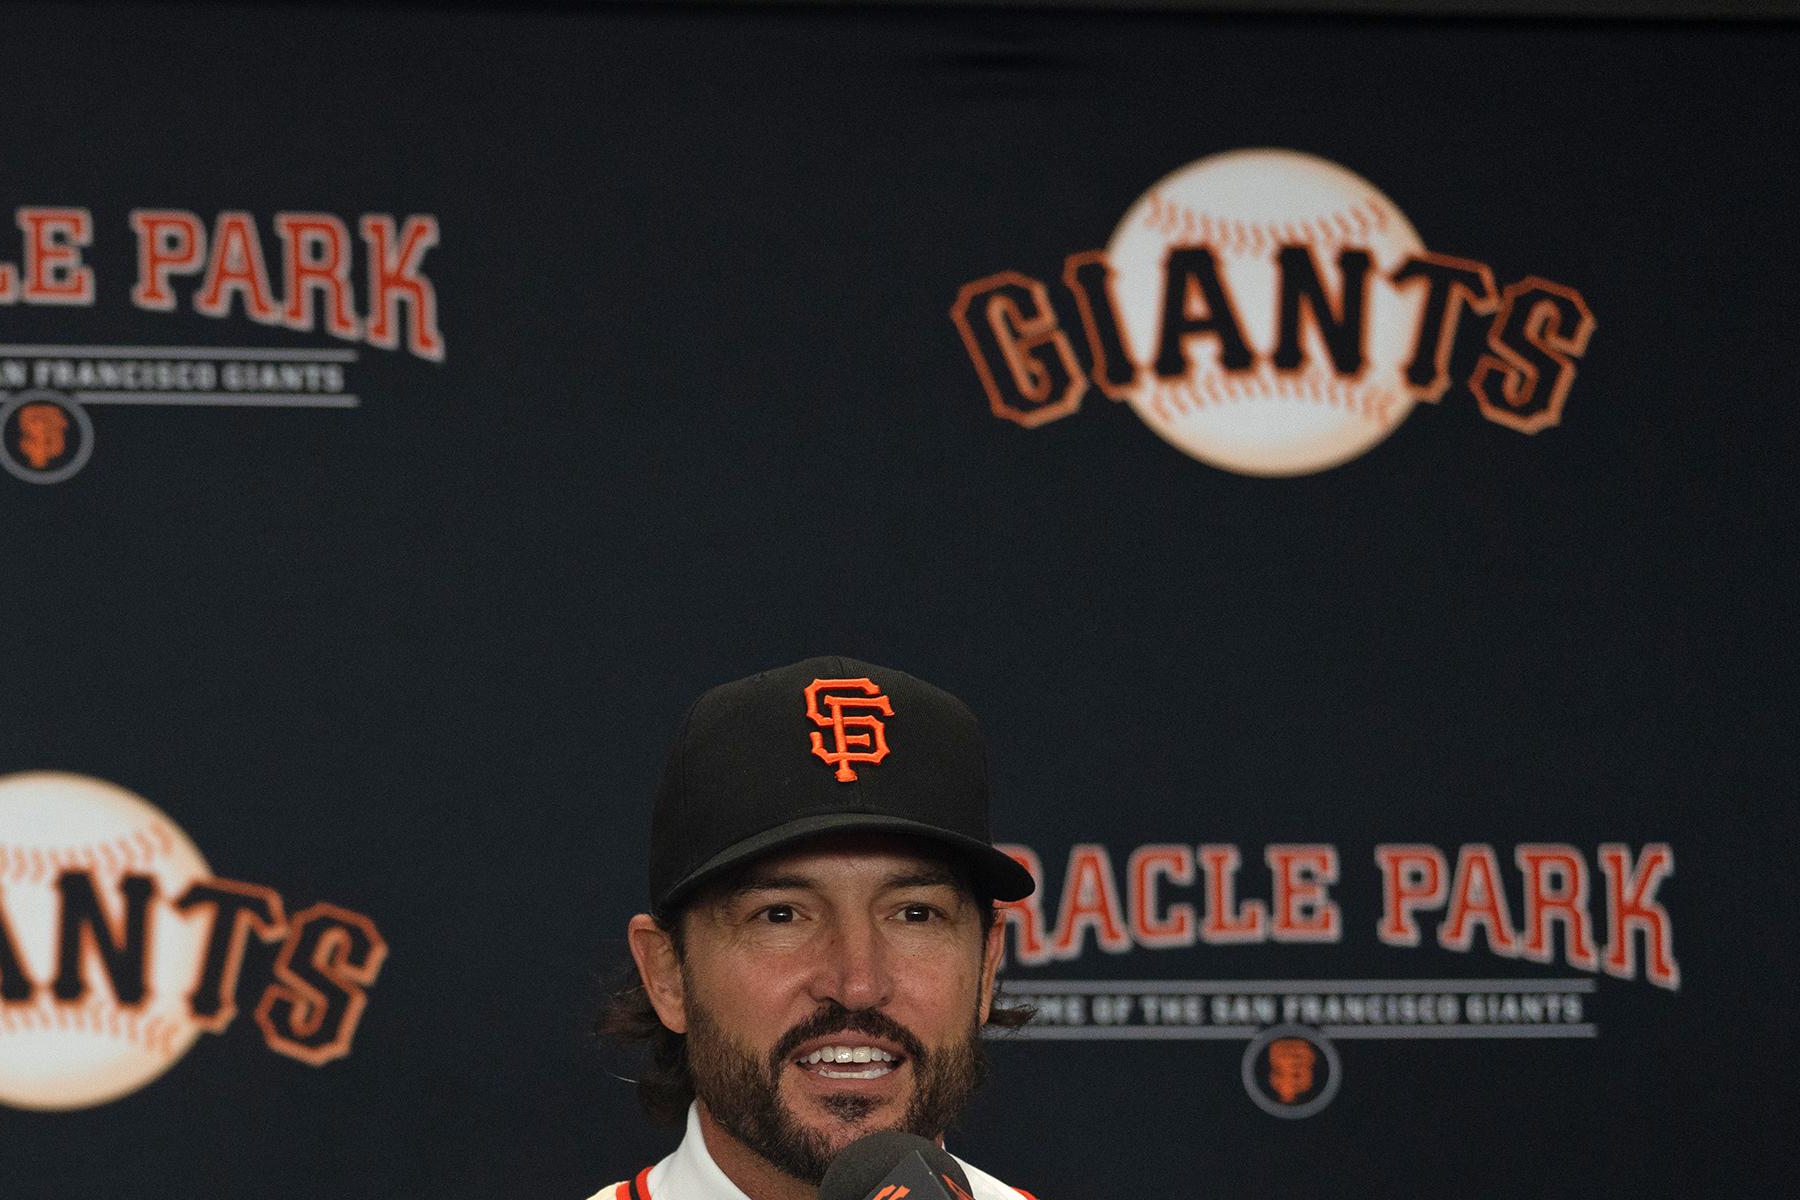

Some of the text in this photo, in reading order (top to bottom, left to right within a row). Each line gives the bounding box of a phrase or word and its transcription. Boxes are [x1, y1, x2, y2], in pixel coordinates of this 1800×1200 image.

[130, 206, 445, 362] PARK
[950, 241, 1597, 435] GIANTS
[33, 359, 217, 390] FRANCISCO
[222, 361, 344, 392] GIANTS
[803, 677, 896, 784] SF
[993, 842, 1681, 991] RACLE PARK
[1091, 995, 1133, 1025] OF
[1139, 995, 1204, 1025] THE
[1211, 995, 1277, 1025] SAN
[1465, 995, 1583, 1025] GIANTS
